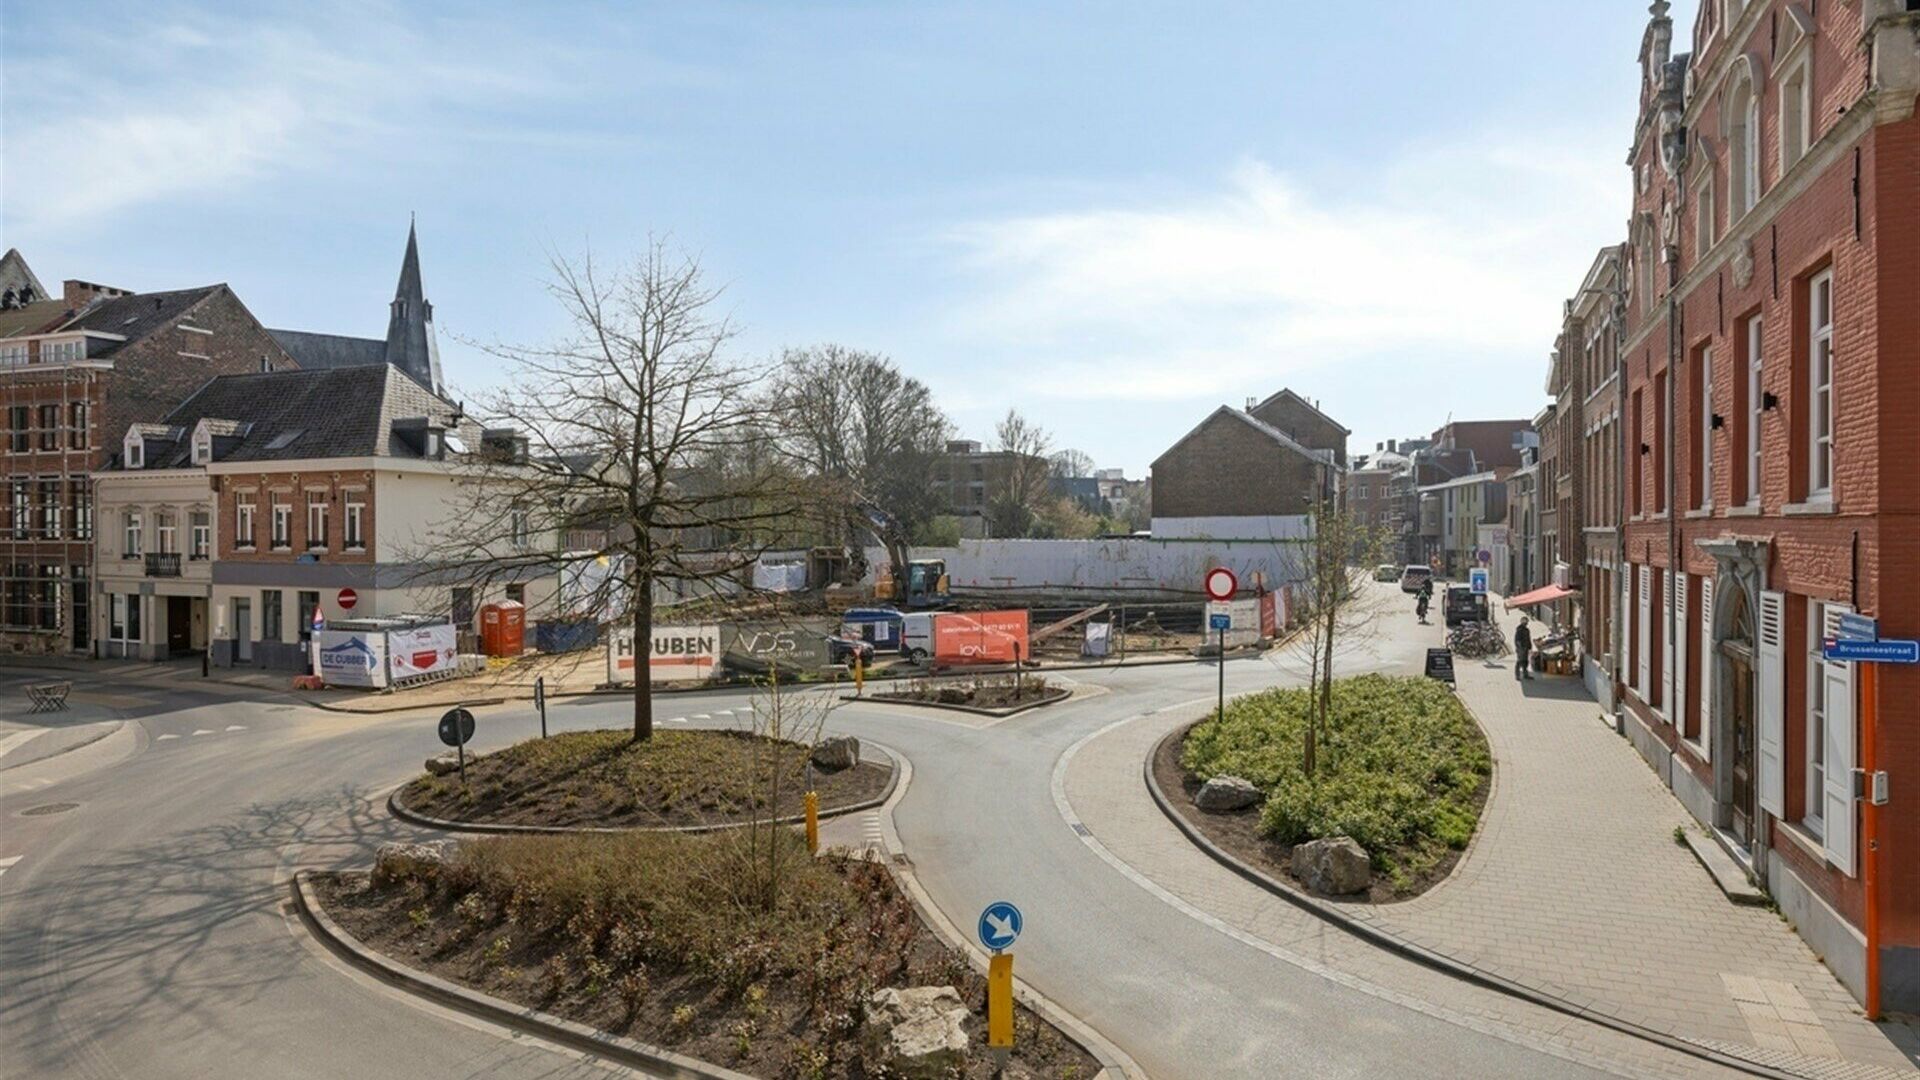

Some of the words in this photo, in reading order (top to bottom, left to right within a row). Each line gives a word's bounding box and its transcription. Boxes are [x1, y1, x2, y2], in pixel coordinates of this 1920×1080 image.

[618, 636, 713, 656] HUBEN
[738, 630, 796, 653] VDS
[1839, 644, 1912, 655] Brusselsestraat
